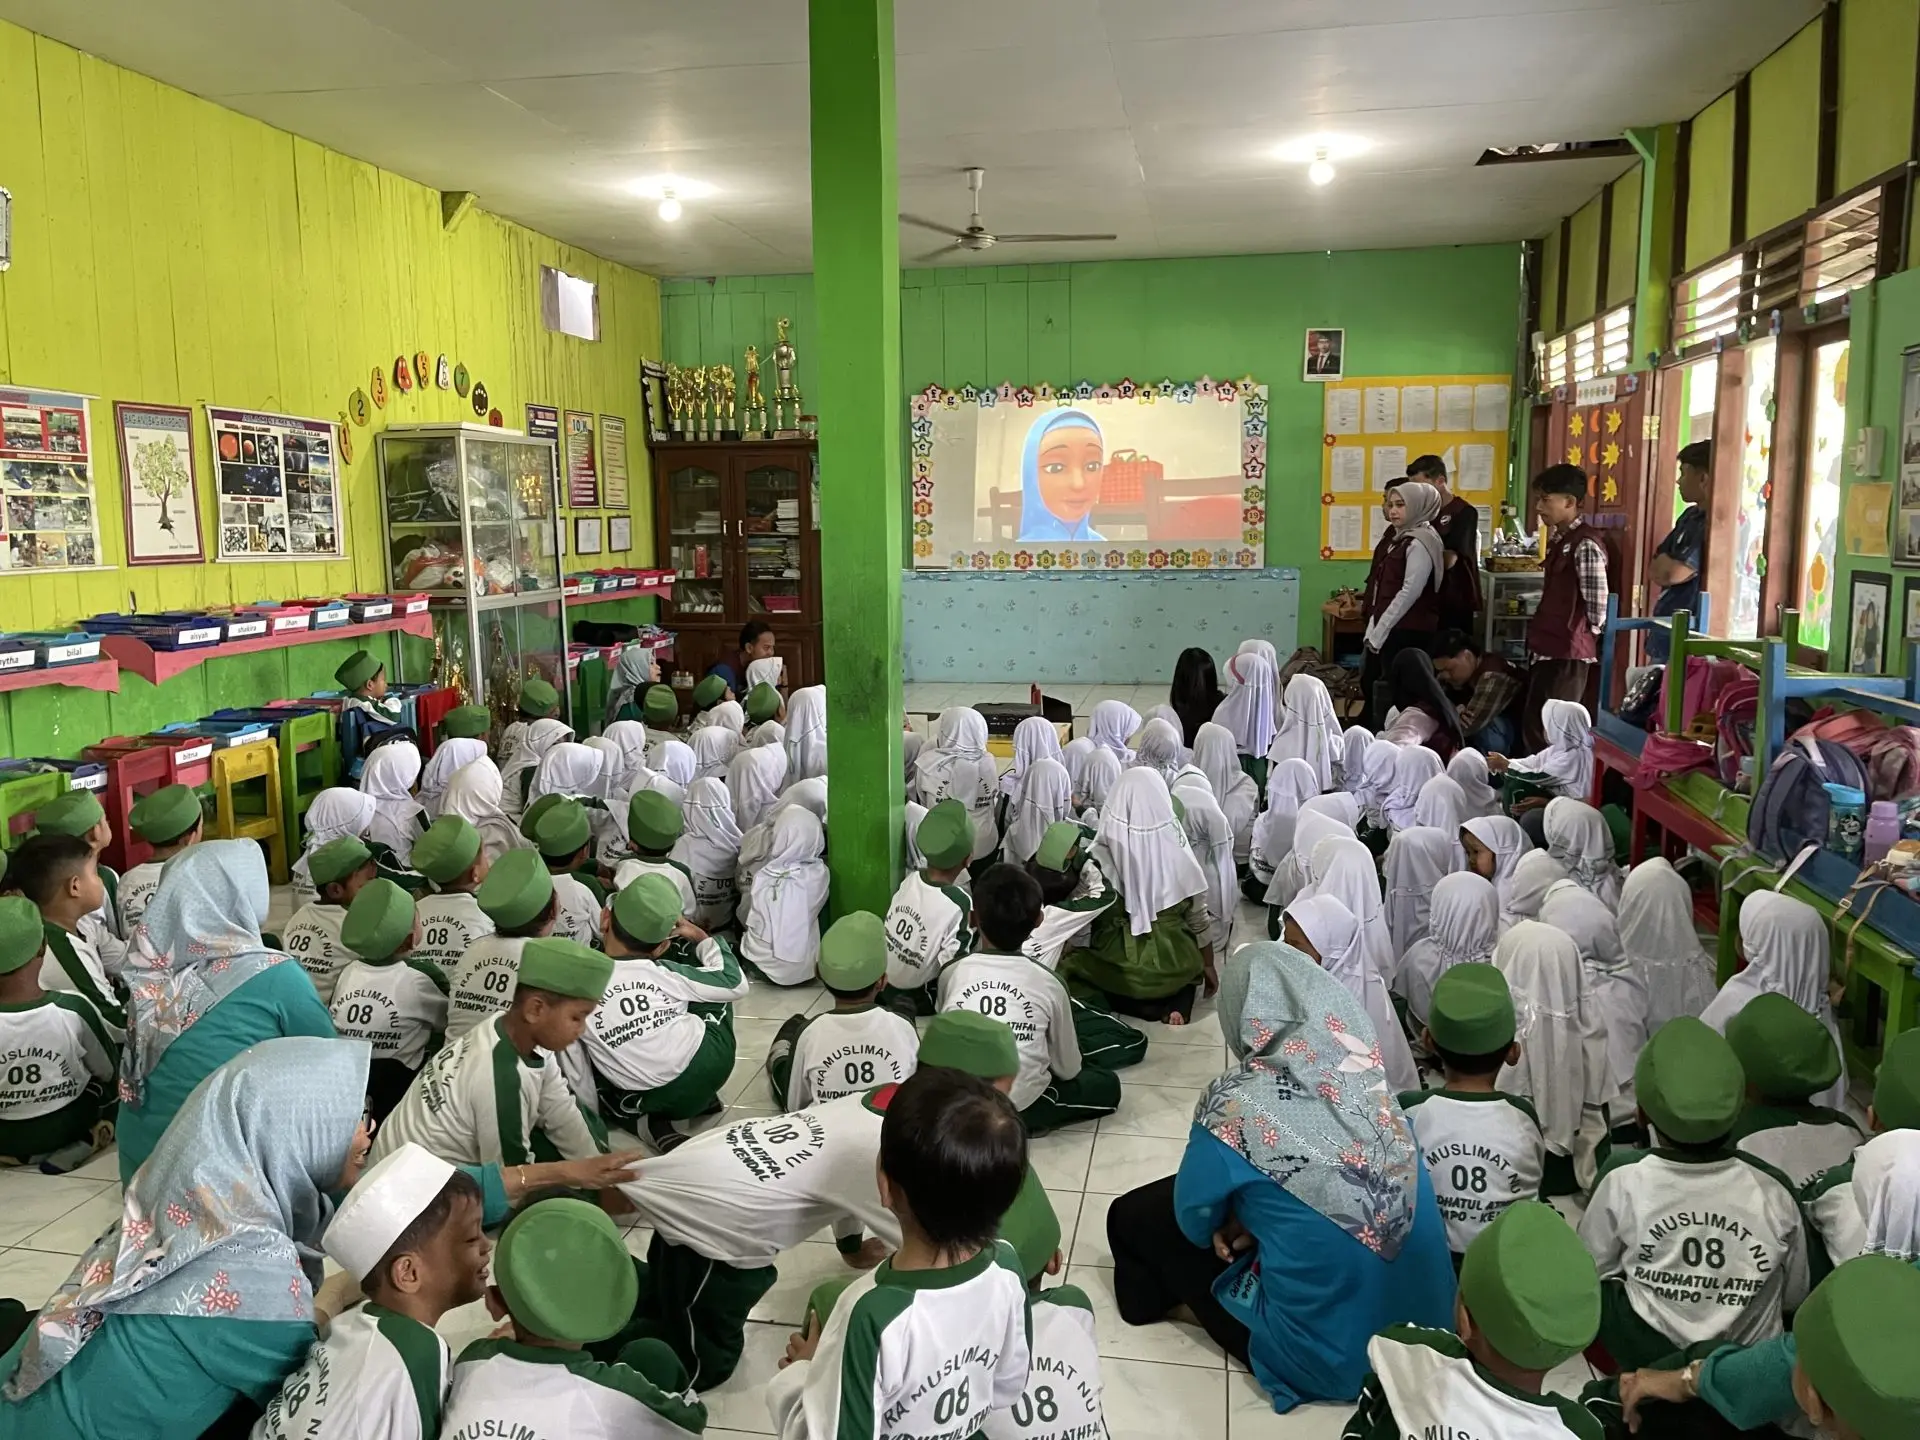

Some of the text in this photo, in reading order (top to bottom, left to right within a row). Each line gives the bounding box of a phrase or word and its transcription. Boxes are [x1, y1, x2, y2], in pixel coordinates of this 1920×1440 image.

[422, 362, 427, 378] 5
[460, 372, 465, 387] 7
[377, 378, 383, 395] 3
[1080, 386, 1089, 395] n
[1123, 385, 1131, 395] p
[1163, 384, 1171, 392] r
[1203, 383, 1210, 391] t
[1222, 387, 1231, 396] u
[1243, 383, 1251, 391] v
[931, 389, 937, 399] f
[965, 389, 974, 398] h
[1003, 386, 1009, 398] j
[1101, 391, 1109, 399] o
[1142, 390, 1151, 400] q
[1183, 389, 1189, 397] s
[947, 395, 955, 406] g
[985, 394, 991, 403] i
[1021, 393, 1030, 403] k
[357, 399, 365, 417] 2
[917, 402, 925, 411] e
[1250, 401, 1262, 410] w
[918, 423, 926, 433] d
[1251, 423, 1260, 431] x
[342, 428, 348, 445] 1
[919, 442, 926, 451] c
[1250, 444, 1259, 453] y
[919, 463, 927, 473] b
[1251, 464, 1258, 472] z
[919, 482, 927, 491] a
[1249, 491, 1260, 499] 20
[921, 505, 926, 513] 1
[1249, 512, 1259, 520] 19
[920, 525, 926, 533] 2
[1249, 533, 1258, 541] 18
[920, 544, 926, 553] 3
[956, 556, 962, 565] 4
[978, 556, 984, 565] 5
[998, 556, 1005, 564] 6
[1021, 556, 1027, 564] 7
[1043, 556, 1049, 564] 8
[1086, 555, 1096, 563] 10
[1111, 555, 1118, 563] 11
[1132, 555, 1142, 563] 12
[1154, 555, 1164, 563] 13
[1175, 554, 1185, 562] 14
[1197, 554, 1207, 562] 15
[1218, 554, 1227, 562] 16
[1241, 554, 1250, 562] 17
[66, 647, 82, 657] bilal
[421, 915, 466, 931] USLIMAT
[896, 918, 913, 941] 08
[426, 928, 448, 945] 08
[289, 934, 311, 952] 08
[920, 935, 928, 951] NU
[323, 942, 333, 957] NU
[441, 958, 459, 966] KEN
[460, 957, 519, 988] RA MUSLIM
[483, 970, 510, 994] 08
[962, 980, 1025, 1001] MUSLIMAT
[1022, 1001, 1034, 1019] NU
[337, 989, 400, 1028] MUSLIMAT NU
[594, 981, 662, 1030] RA MUSLIMAT
[619, 994, 650, 1017] 08
[979, 995, 1007, 1017] 08
[347, 1003, 373, 1025] 08
[0, 1047, 71, 1077] USLIMAT NU
[817, 1044, 902, 1087] RA MUSLIMAT NU
[8, 1063, 42, 1085] 08
[844, 1060, 875, 1085] 08
[0, 1089, 37, 1099] HATUL
[763, 1123, 800, 1144] 08
[749, 1147, 786, 1180] ATHFAL
[785, 1149, 813, 1168] NU
[1425, 1143, 1522, 1194] MUSLIMAT NU
[1451, 1164, 1488, 1194] 08
[1437, 1194, 1483, 1211] DHATUL
[1639, 1211, 1772, 1273] RA MUSLIMAT NU
[1681, 1236, 1726, 1269] 08
[1634, 1266, 1764, 1292] RAUDHATUL ATHF
[883, 1345, 1000, 1429] RA MUSLIMAT
[933, 1375, 970, 1425] 08
[1011, 1385, 1058, 1428] 08
[452, 1419, 547, 1440] MUSLIM
